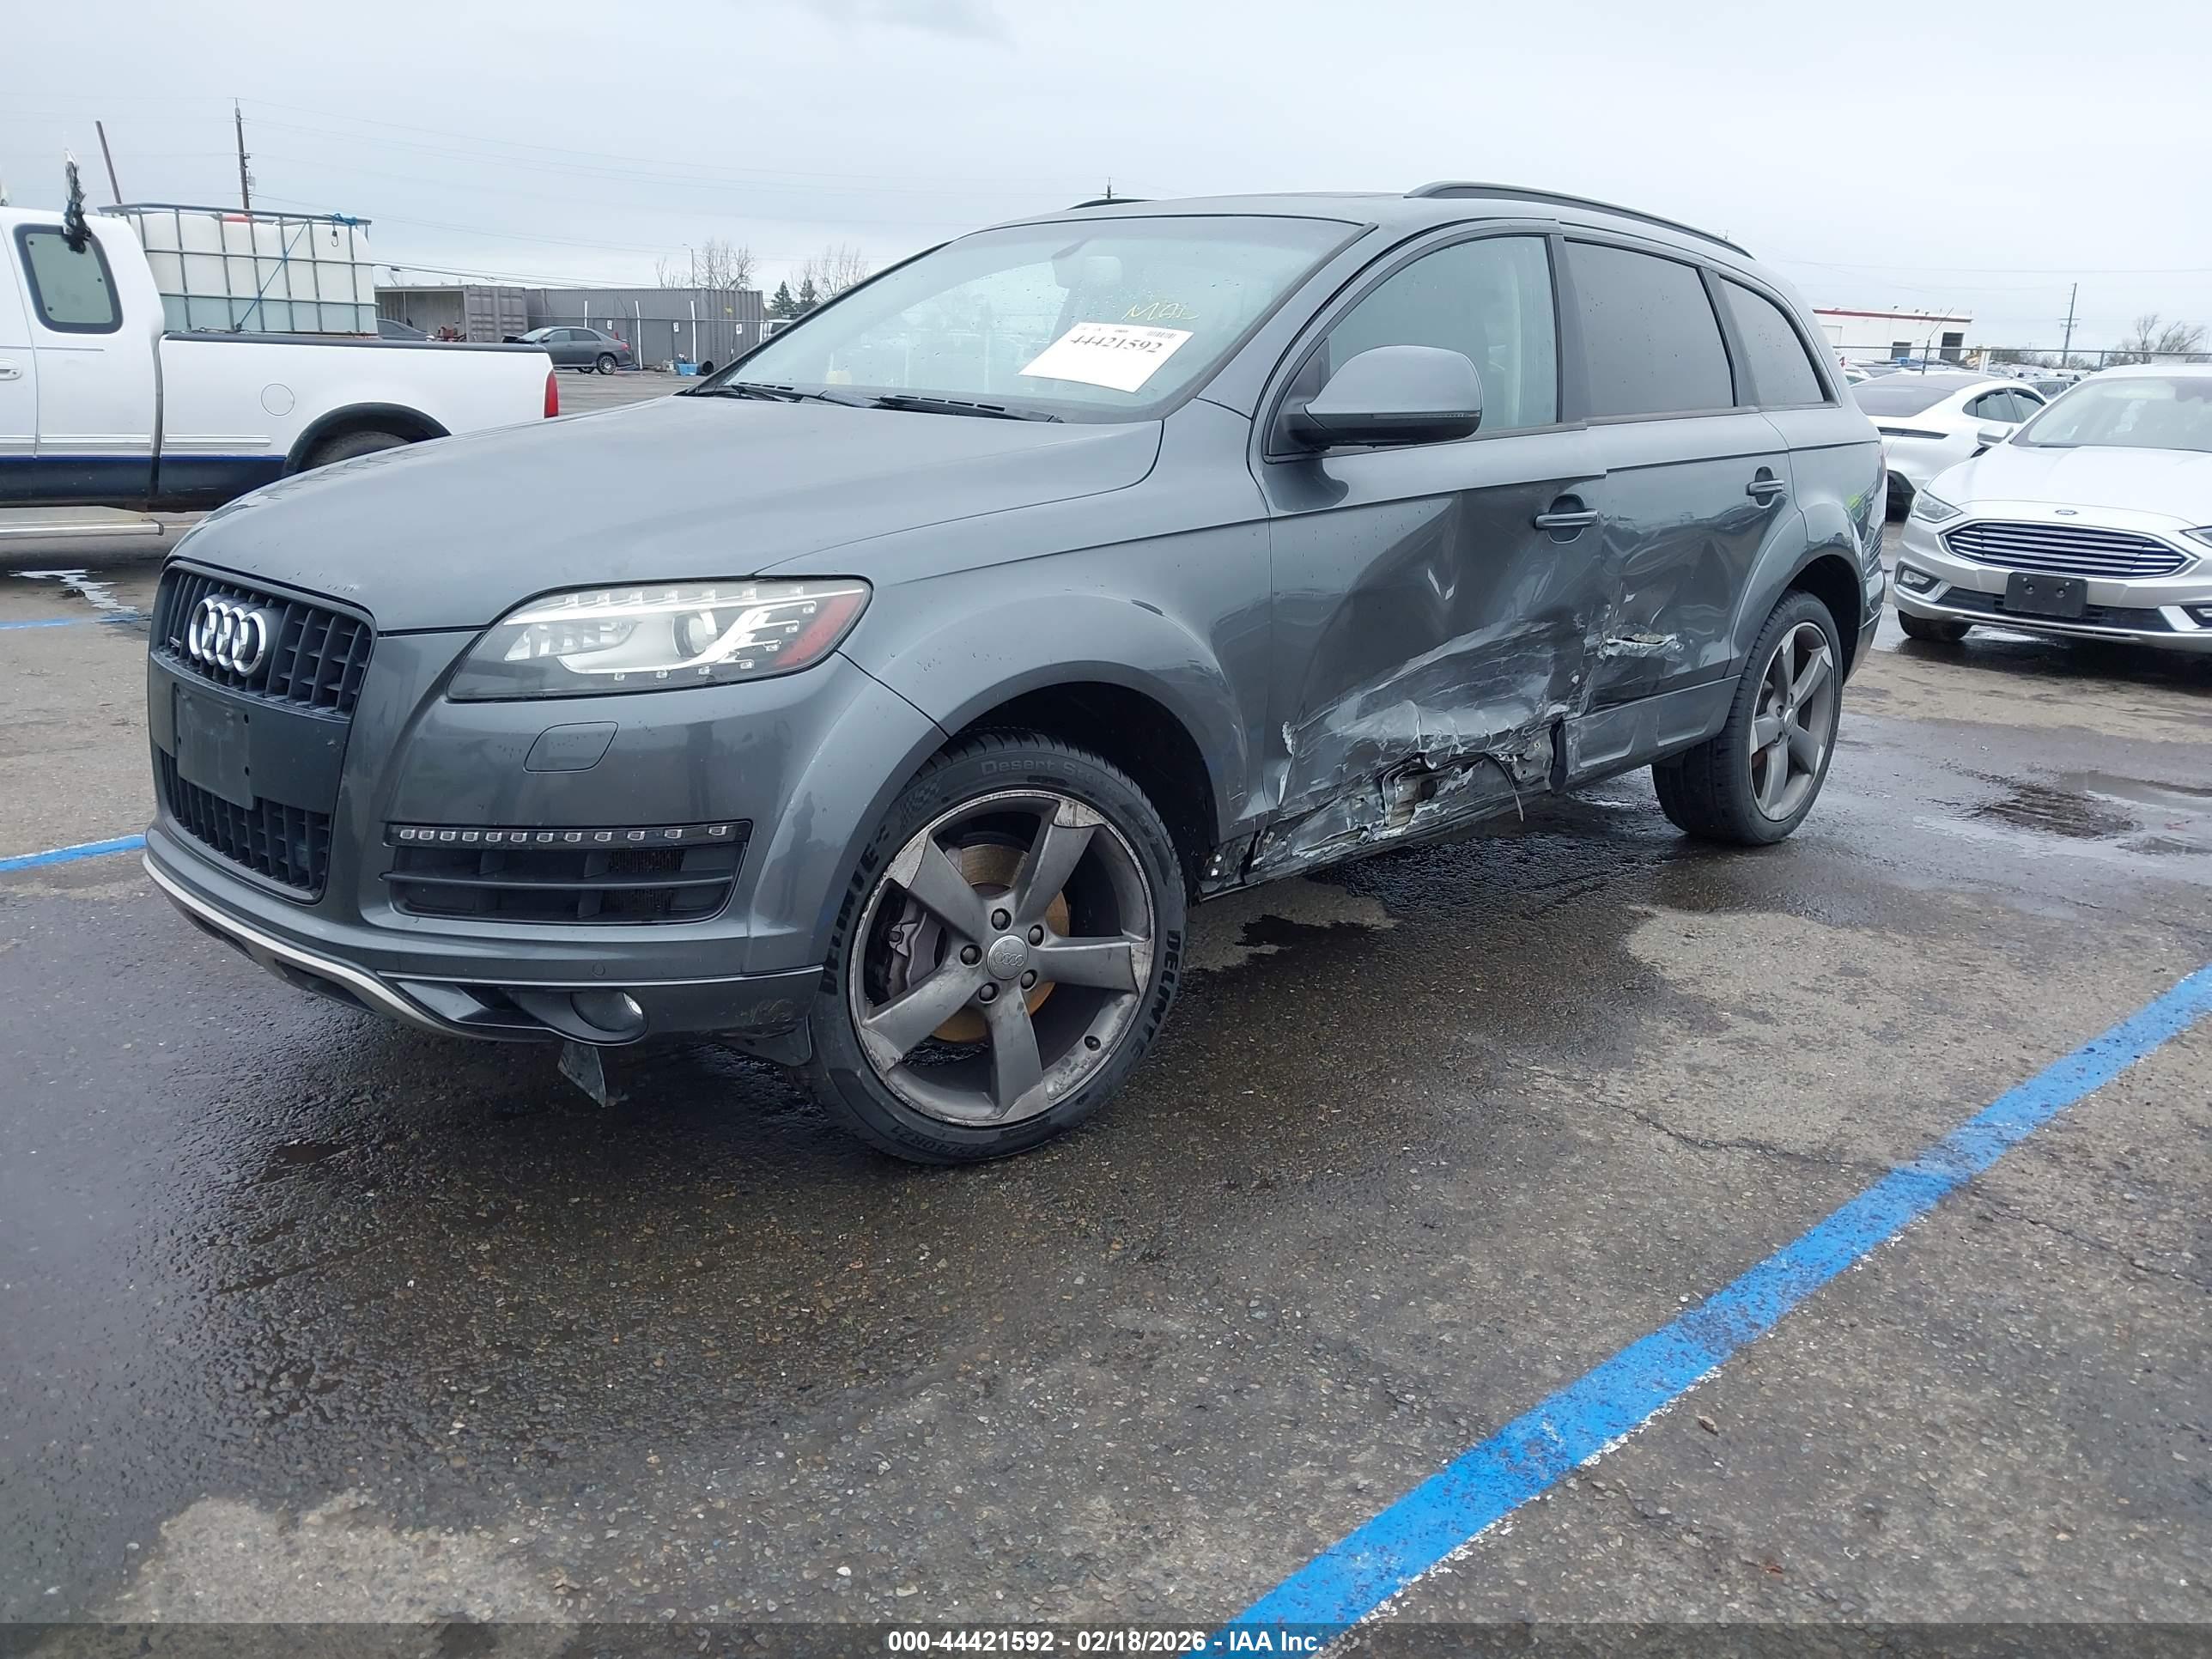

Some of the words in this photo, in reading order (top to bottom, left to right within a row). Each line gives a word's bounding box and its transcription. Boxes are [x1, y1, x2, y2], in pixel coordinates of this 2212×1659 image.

[1070, 334, 1163, 353] 44421592
[981, 759, 1055, 775] Desert
[1121, 929, 1181, 1060] DELINTE
